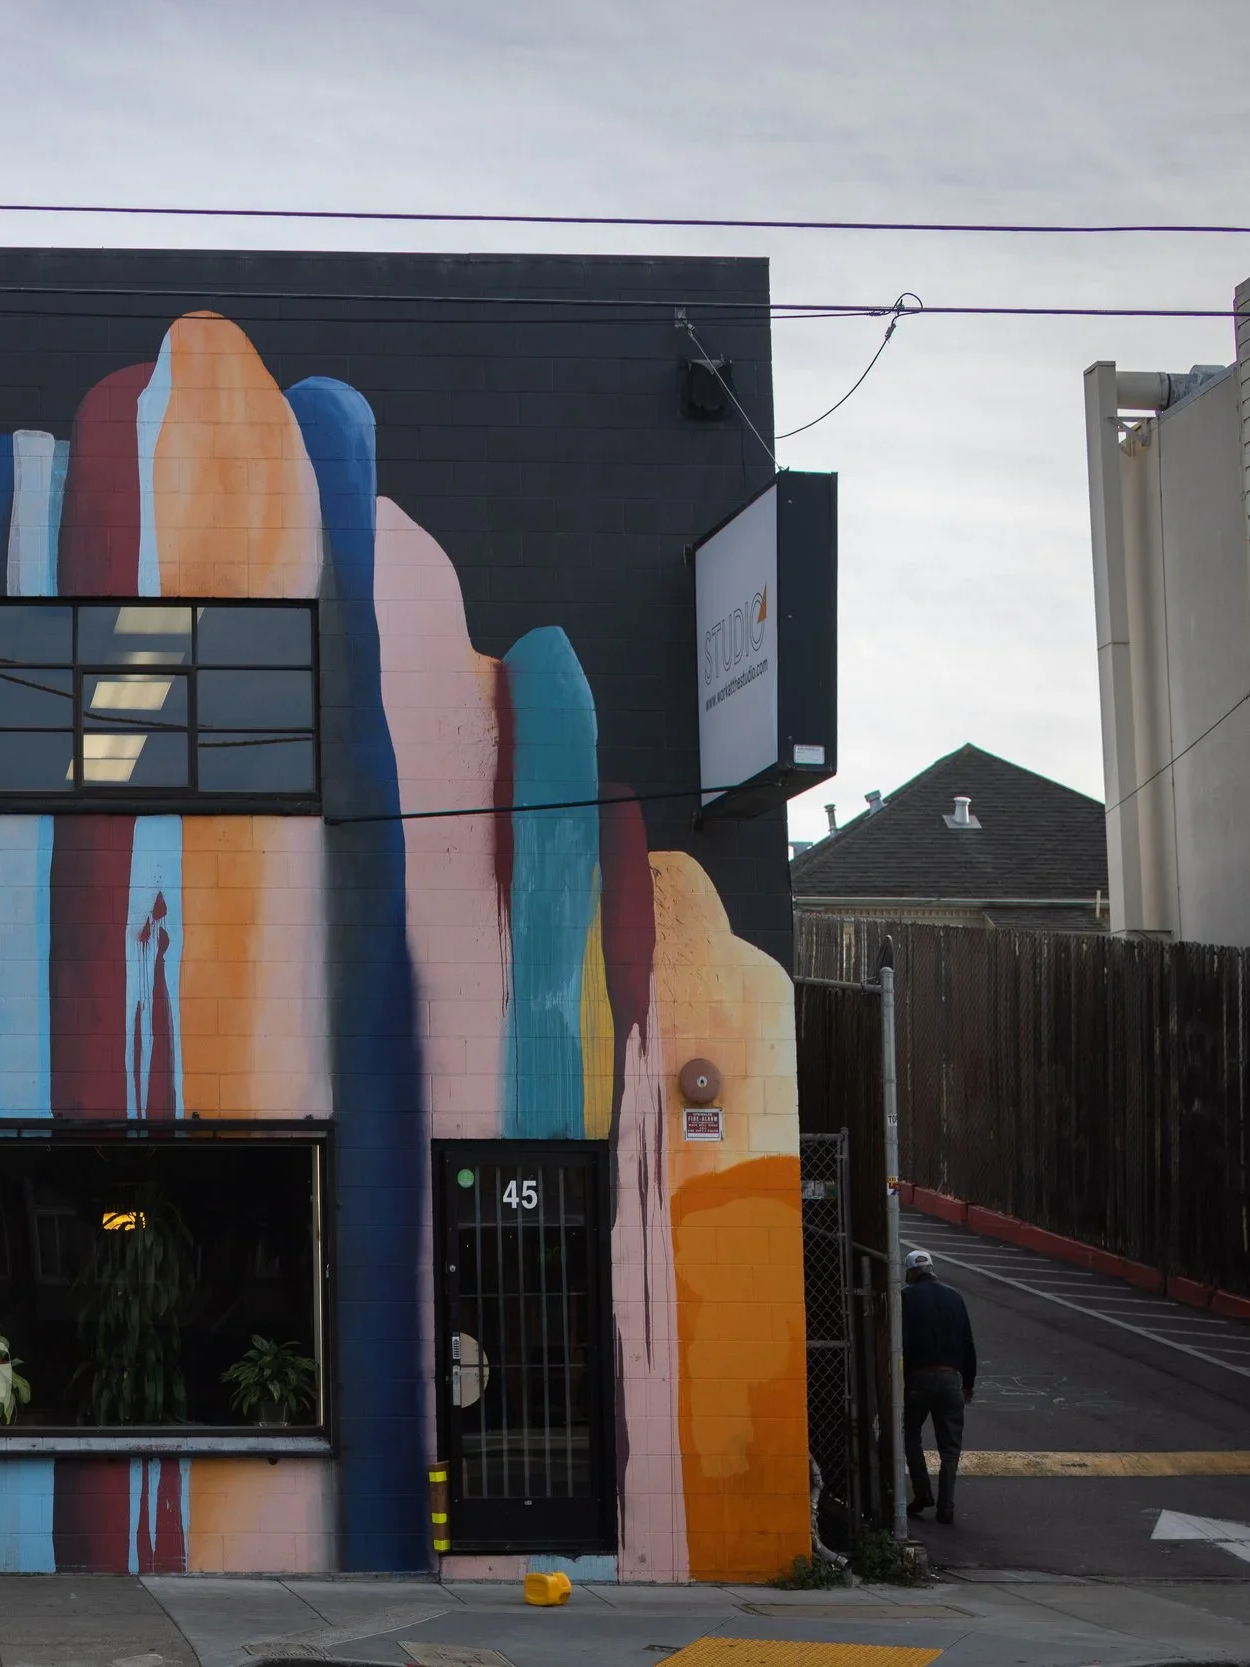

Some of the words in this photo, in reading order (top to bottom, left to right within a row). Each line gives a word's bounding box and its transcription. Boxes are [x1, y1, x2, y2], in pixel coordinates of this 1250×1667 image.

[704, 592, 766, 685] STUDIO
[705, 658, 769, 712] www.workatthestudio.com
[502, 1180, 538, 1209] 45
